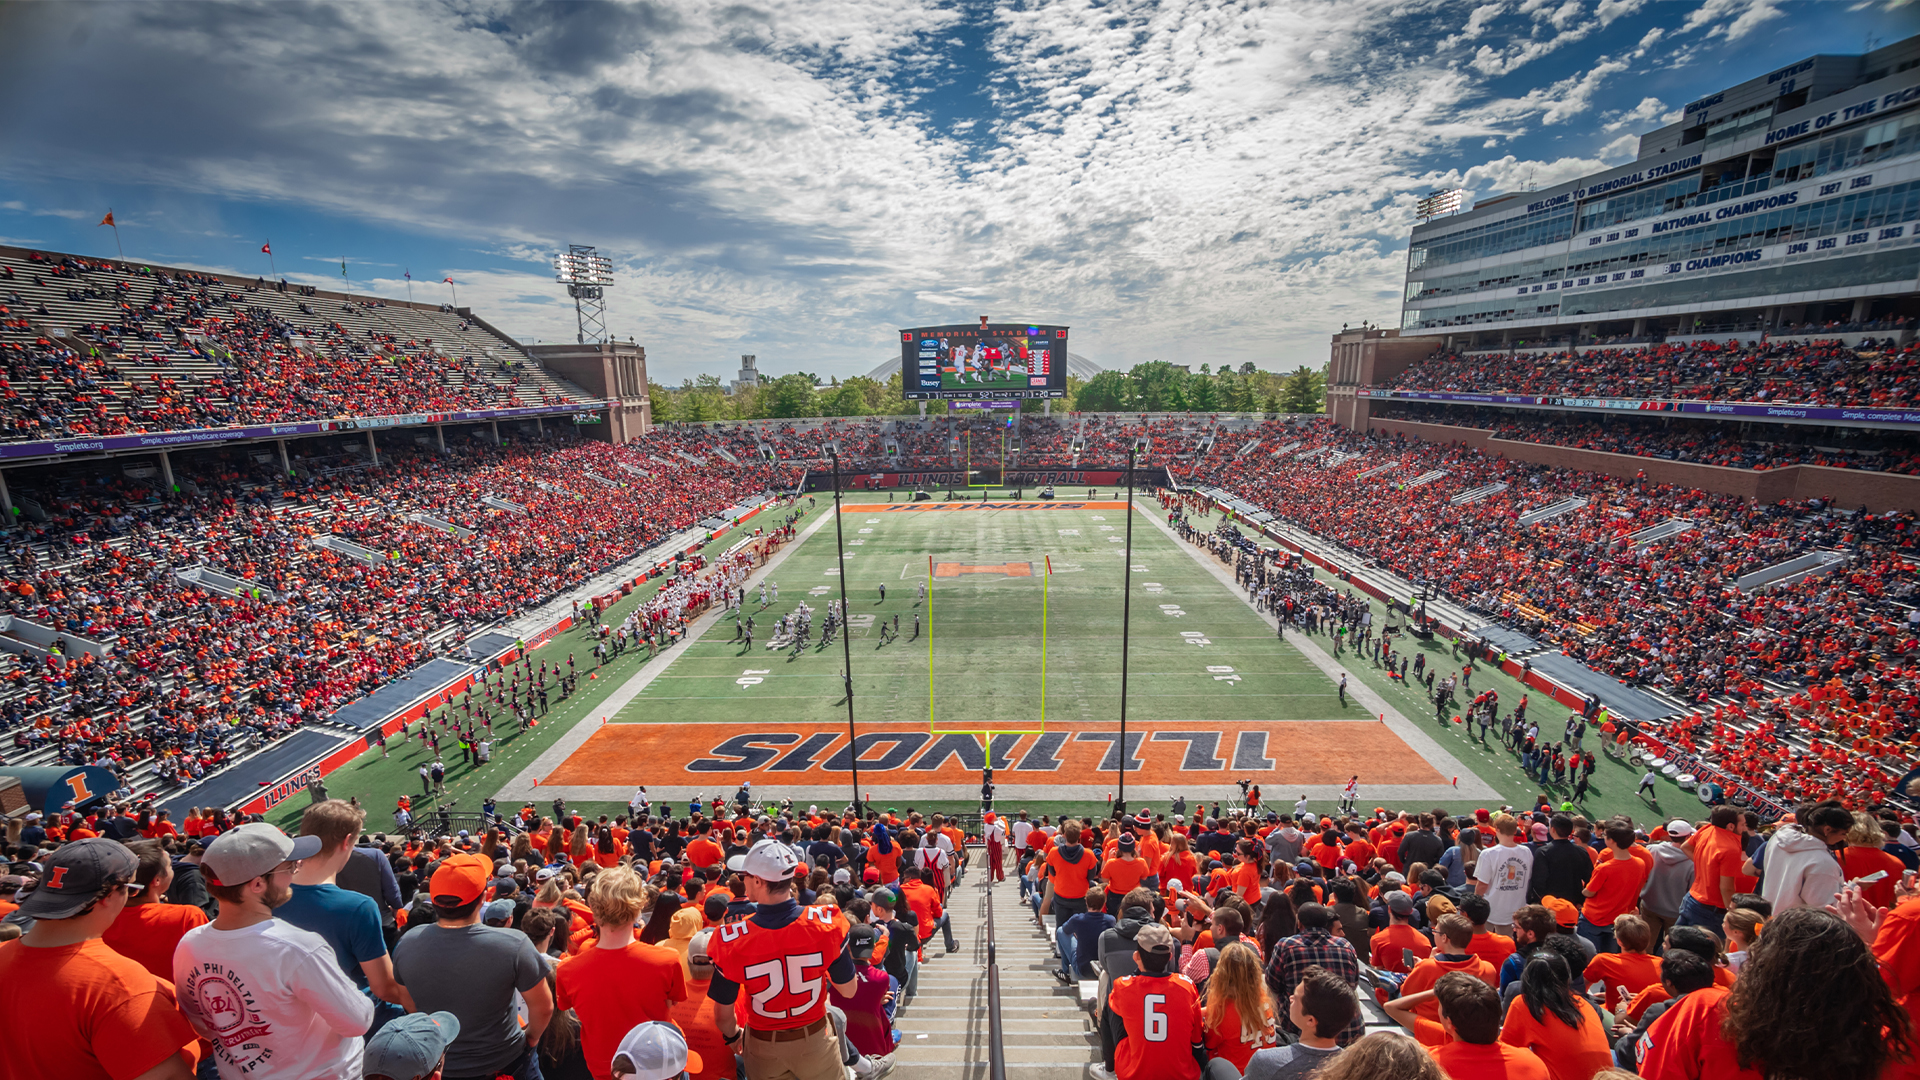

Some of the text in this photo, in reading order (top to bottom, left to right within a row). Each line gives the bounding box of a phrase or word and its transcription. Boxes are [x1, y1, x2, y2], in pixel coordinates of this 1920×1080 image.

[1768, 58, 1814, 84] BUTKUS
[1780, 78, 1796, 96] 50
[1686, 93, 1724, 114] GRANGE
[1696, 110, 1708, 126] 77
[1764, 120, 1810, 146] HOME
[1814, 112, 1837, 130] OF
[1843, 98, 1879, 122] THE
[1528, 154, 1702, 212] WELCOME TO MEMORIAL STADIUM
[1652, 212, 1712, 234] NATIONAL
[1715, 191, 1798, 220] CHAMPIONS
[1818, 182, 1842, 196] 1927
[1849, 174, 1873, 189] 1951
[1686, 249, 1762, 272] CHAMPIONS
[1786, 242, 1808, 254] 1946
[1816, 238, 1837, 250] 1951
[1845, 232, 1870, 246] 1953
[920, 380, 940, 388] Busey
[1711, 405, 1734, 413] simplete
[1767, 408, 1806, 418] Simplete.org
[1842, 411, 1865, 420] Simple,
[1868, 413, 1901, 421] complete
[54, 440, 103, 452] Simplete.org
[140, 431, 245, 446] Simple, complete Medicare coverage.
[898, 472, 1086, 486] ILLINOIS FOOTBALL
[884, 503, 1087, 511] ILLINOIS
[736, 670, 770, 684] 10
[1206, 666, 1242, 680] 10
[684, 731, 1277, 773] ILLINOIS
[264, 765, 320, 809] ILLINOS
[784, 854, 794, 865] I
[46, 866, 70, 890] I
[187, 963, 255, 1006] SIGMA PHI DELTA
[744, 952, 824, 1019] 25
[1144, 994, 1168, 1042] 6
[212, 1038, 273, 1074] DELTA APTER
[1635, 1030, 1655, 1064] 5
